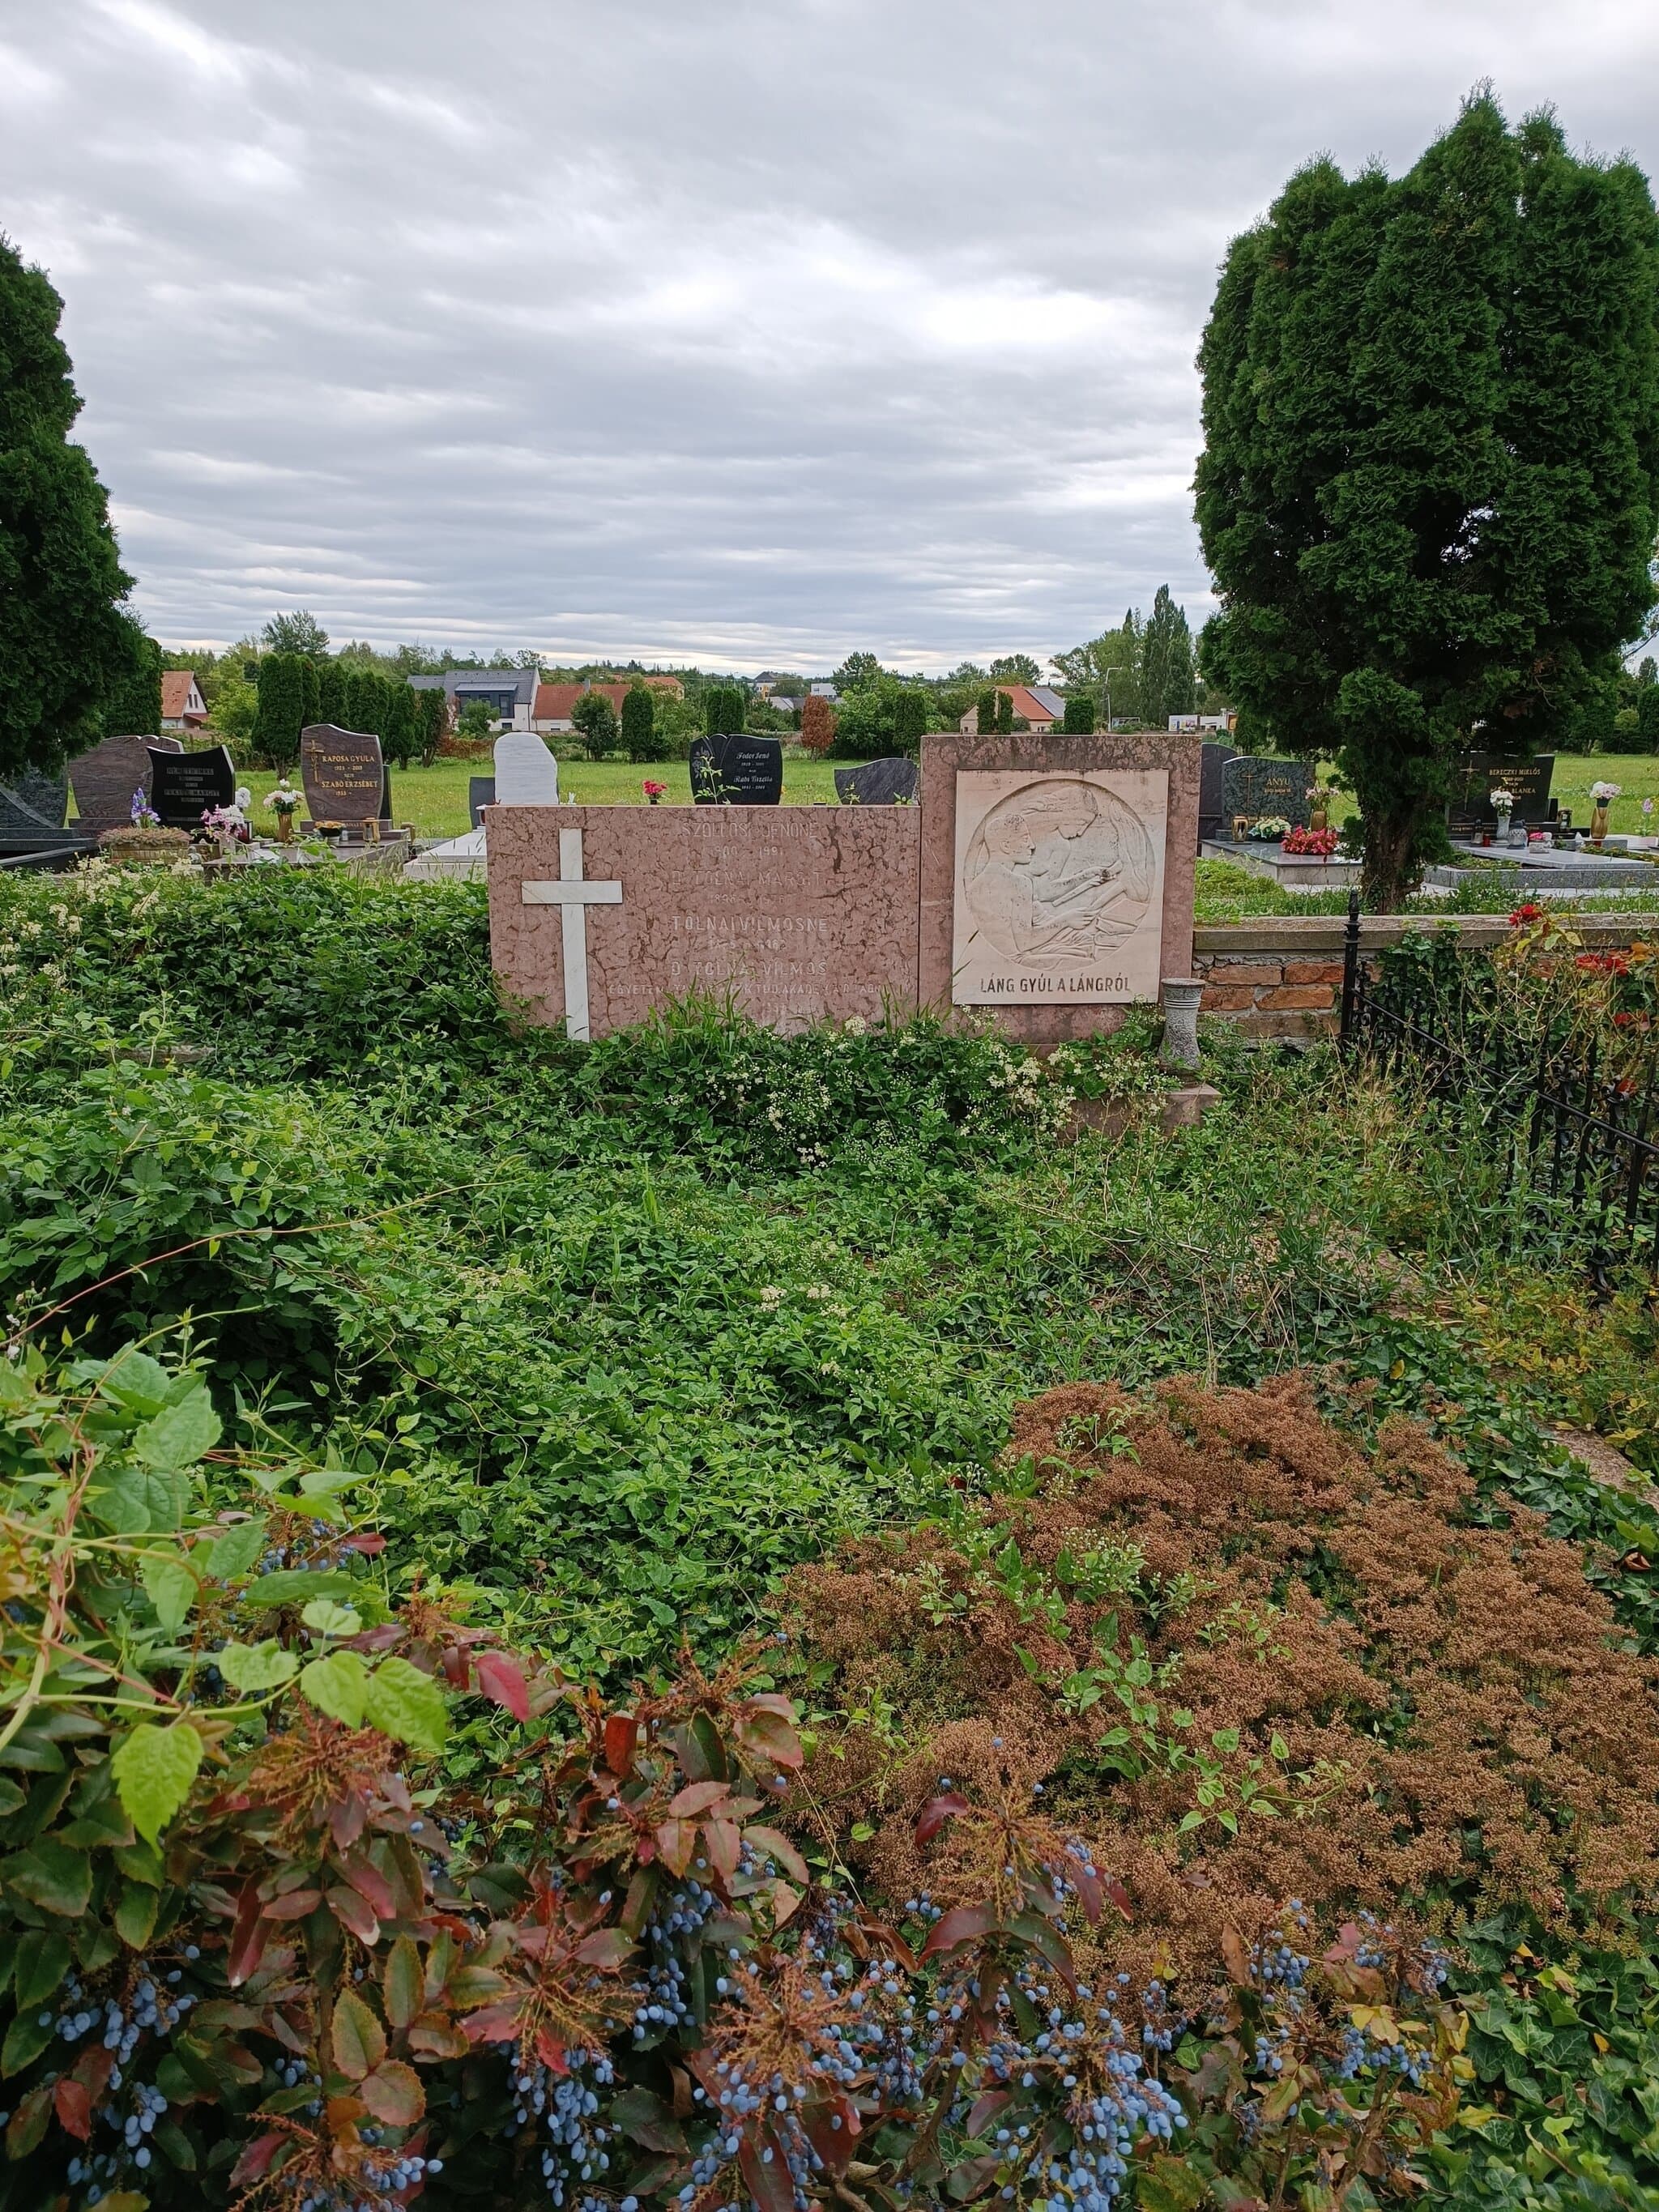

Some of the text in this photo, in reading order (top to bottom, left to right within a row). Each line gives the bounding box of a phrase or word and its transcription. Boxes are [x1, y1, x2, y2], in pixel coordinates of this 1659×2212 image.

[1519, 767, 1541, 775] MIKLÓS
[1266, 778, 1290, 786] ANYU
[672, 916, 736, 931] TOLNAI
[980, 972, 1131, 993] LÁNG GYÚL A LÁNGRÓL
